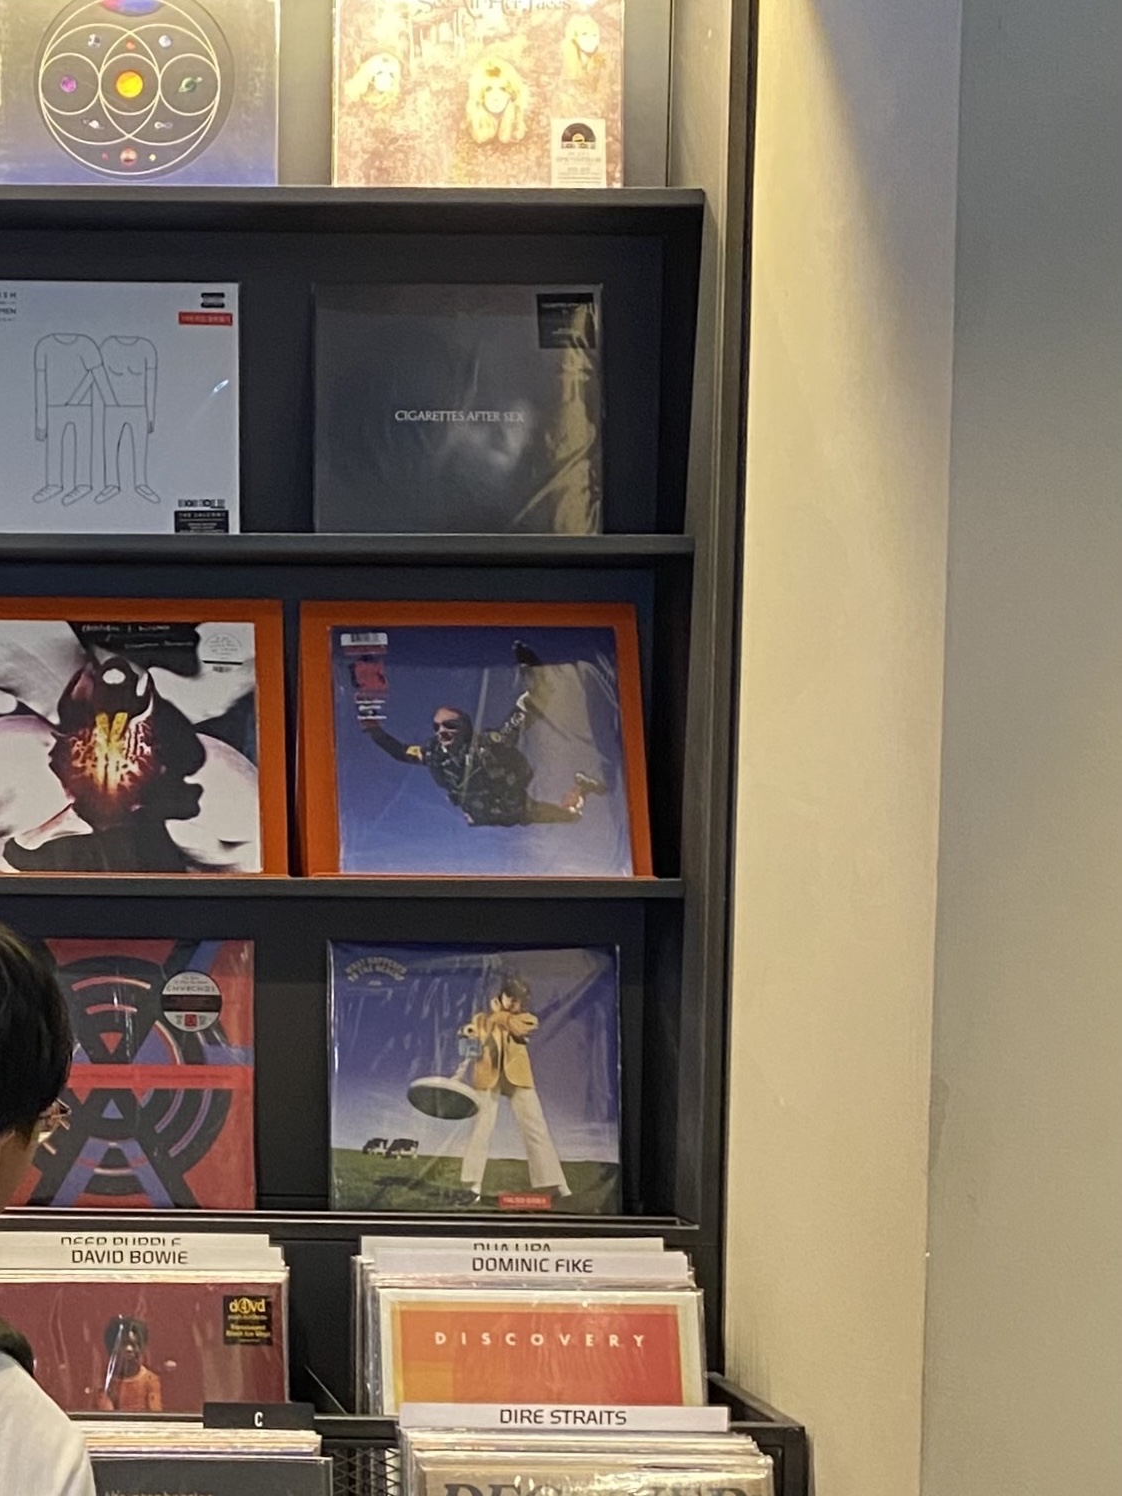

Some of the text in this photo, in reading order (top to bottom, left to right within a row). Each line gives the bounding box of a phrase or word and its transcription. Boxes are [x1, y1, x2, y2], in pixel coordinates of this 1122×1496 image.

[394, 410, 527, 423] CIGARETTES AFTER SEX
[71, 1249, 189, 1265] DAVID BOWIE
[472, 1257, 594, 1273] DOMINIC FIKE
[434, 1331, 645, 1348] DISCOVERY
[254, 1411, 264, 1427] C
[500, 1409, 627, 1425] DIRE STRAITS
